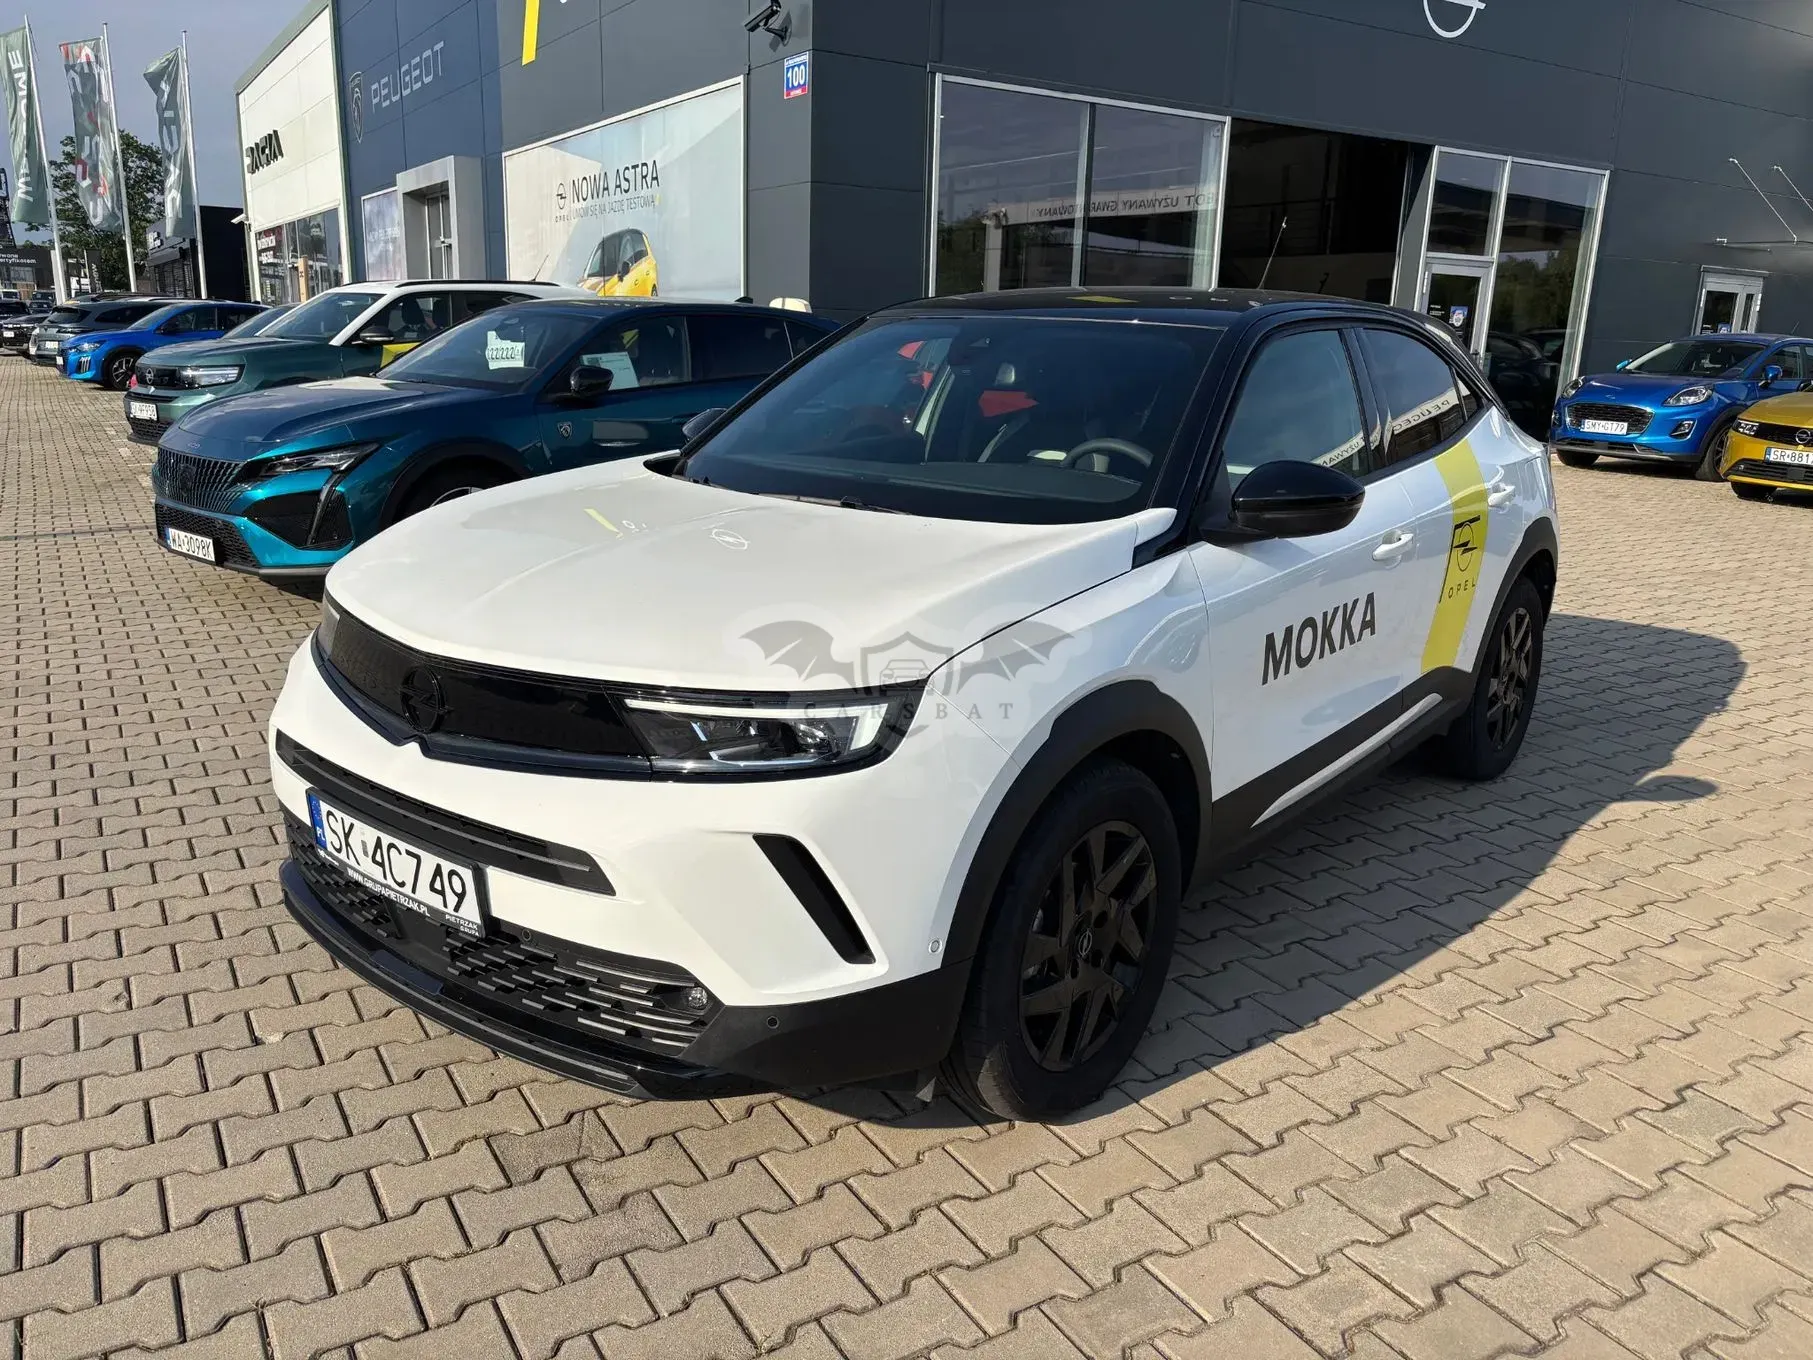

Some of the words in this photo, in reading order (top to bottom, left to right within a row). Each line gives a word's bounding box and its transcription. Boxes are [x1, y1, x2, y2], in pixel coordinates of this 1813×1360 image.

[370, 40, 444, 114] PEUGEOT
[787, 64, 805, 88] 100
[572, 171, 610, 203] NOWA
[614, 159, 660, 196] ASTRA
[1586, 420, 1601, 431] SMY
[1603, 421, 1625, 432] GT79
[1772, 449, 1787, 461] SR
[170, 530, 183, 551] WA
[185, 534, 214, 560] 3098K
[1448, 578, 1477, 599] OPEL
[1261, 591, 1376, 686] MOKKA
[326, 809, 361, 867] SK
[371, 835, 467, 913] 4C749
[445, 914, 479, 931] PIETRZAK
[460, 925, 480, 937] GRUPA
